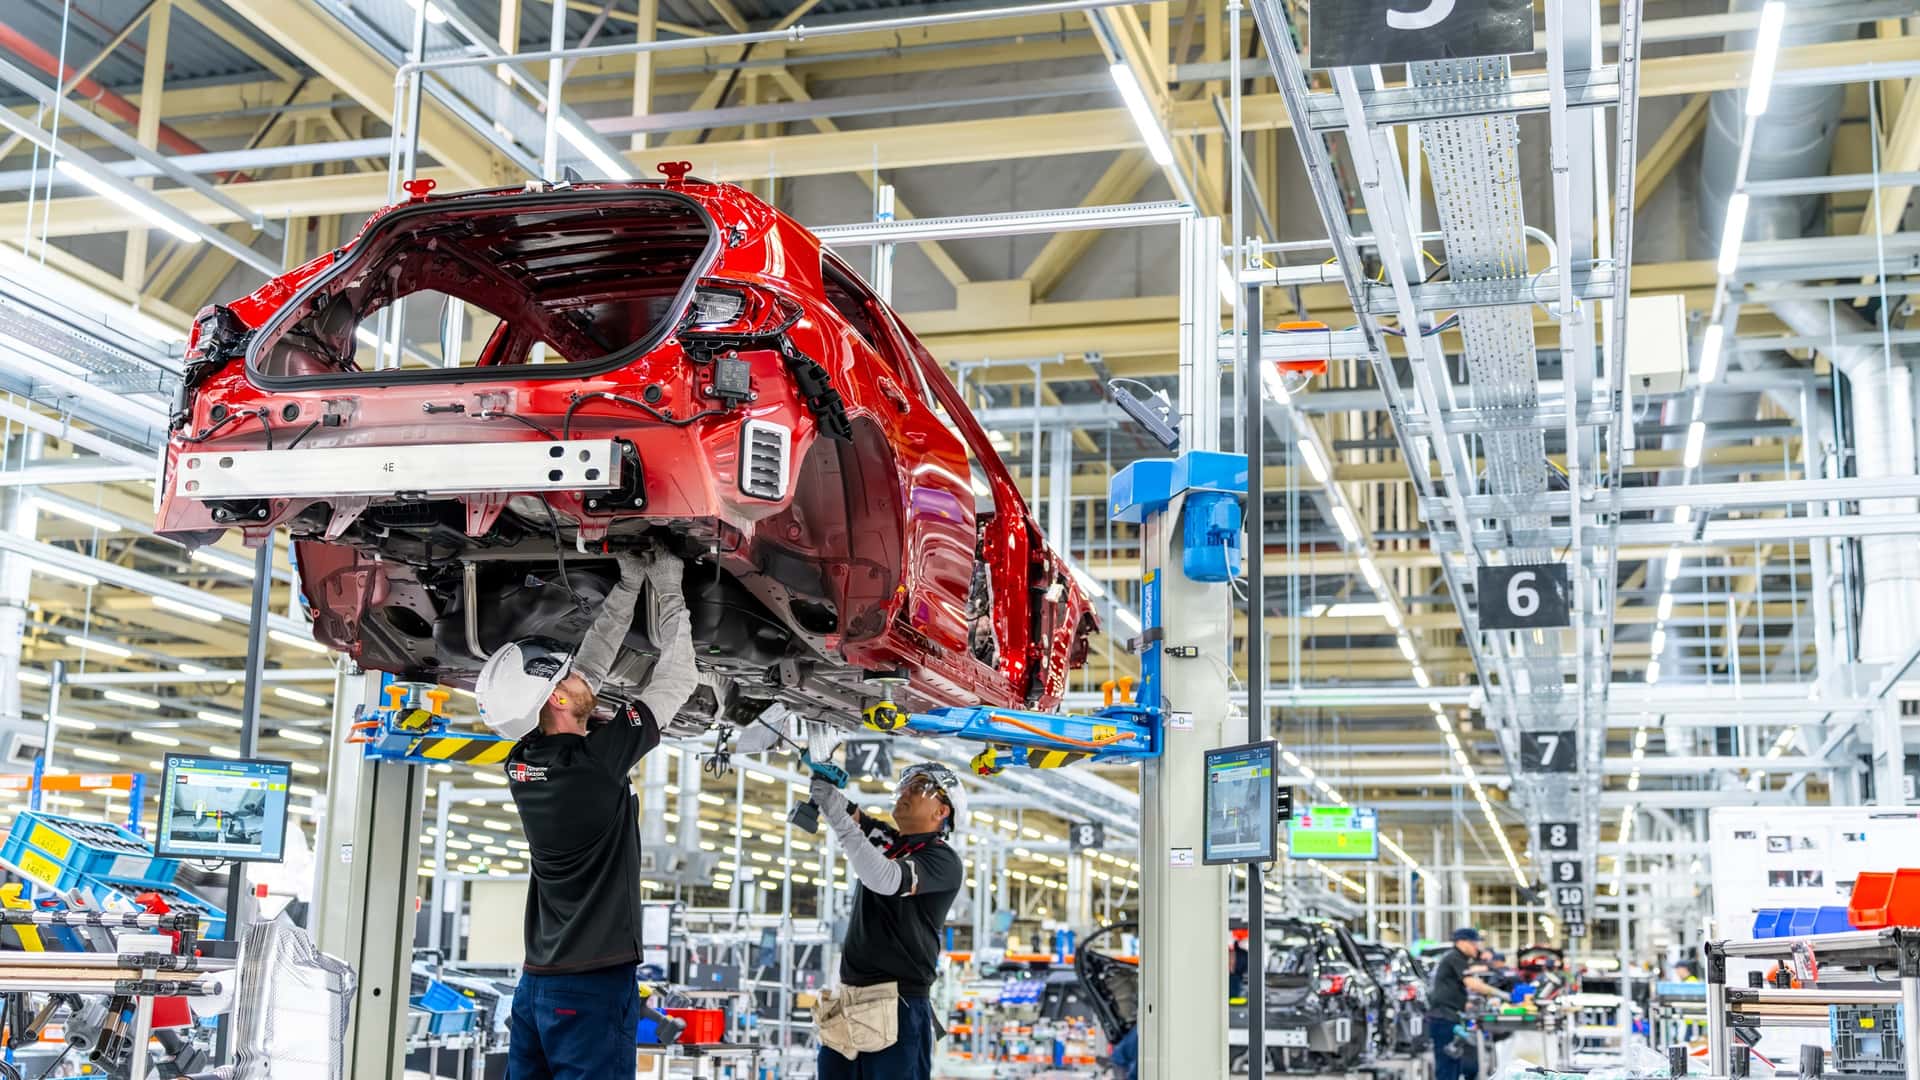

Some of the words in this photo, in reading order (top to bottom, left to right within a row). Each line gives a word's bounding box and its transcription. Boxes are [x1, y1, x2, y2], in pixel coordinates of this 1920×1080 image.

[383, 462, 394, 472] 4E
[1507, 570, 1540, 617] 6
[860, 743, 880, 772] 7
[1537, 735, 1559, 766] 7
[1079, 825, 1094, 845] 8
[1550, 824, 1568, 847] 8
[1559, 862, 1575, 882] 9
[1560, 889, 1582, 905] 10
[1565, 910, 1582, 924] 11
